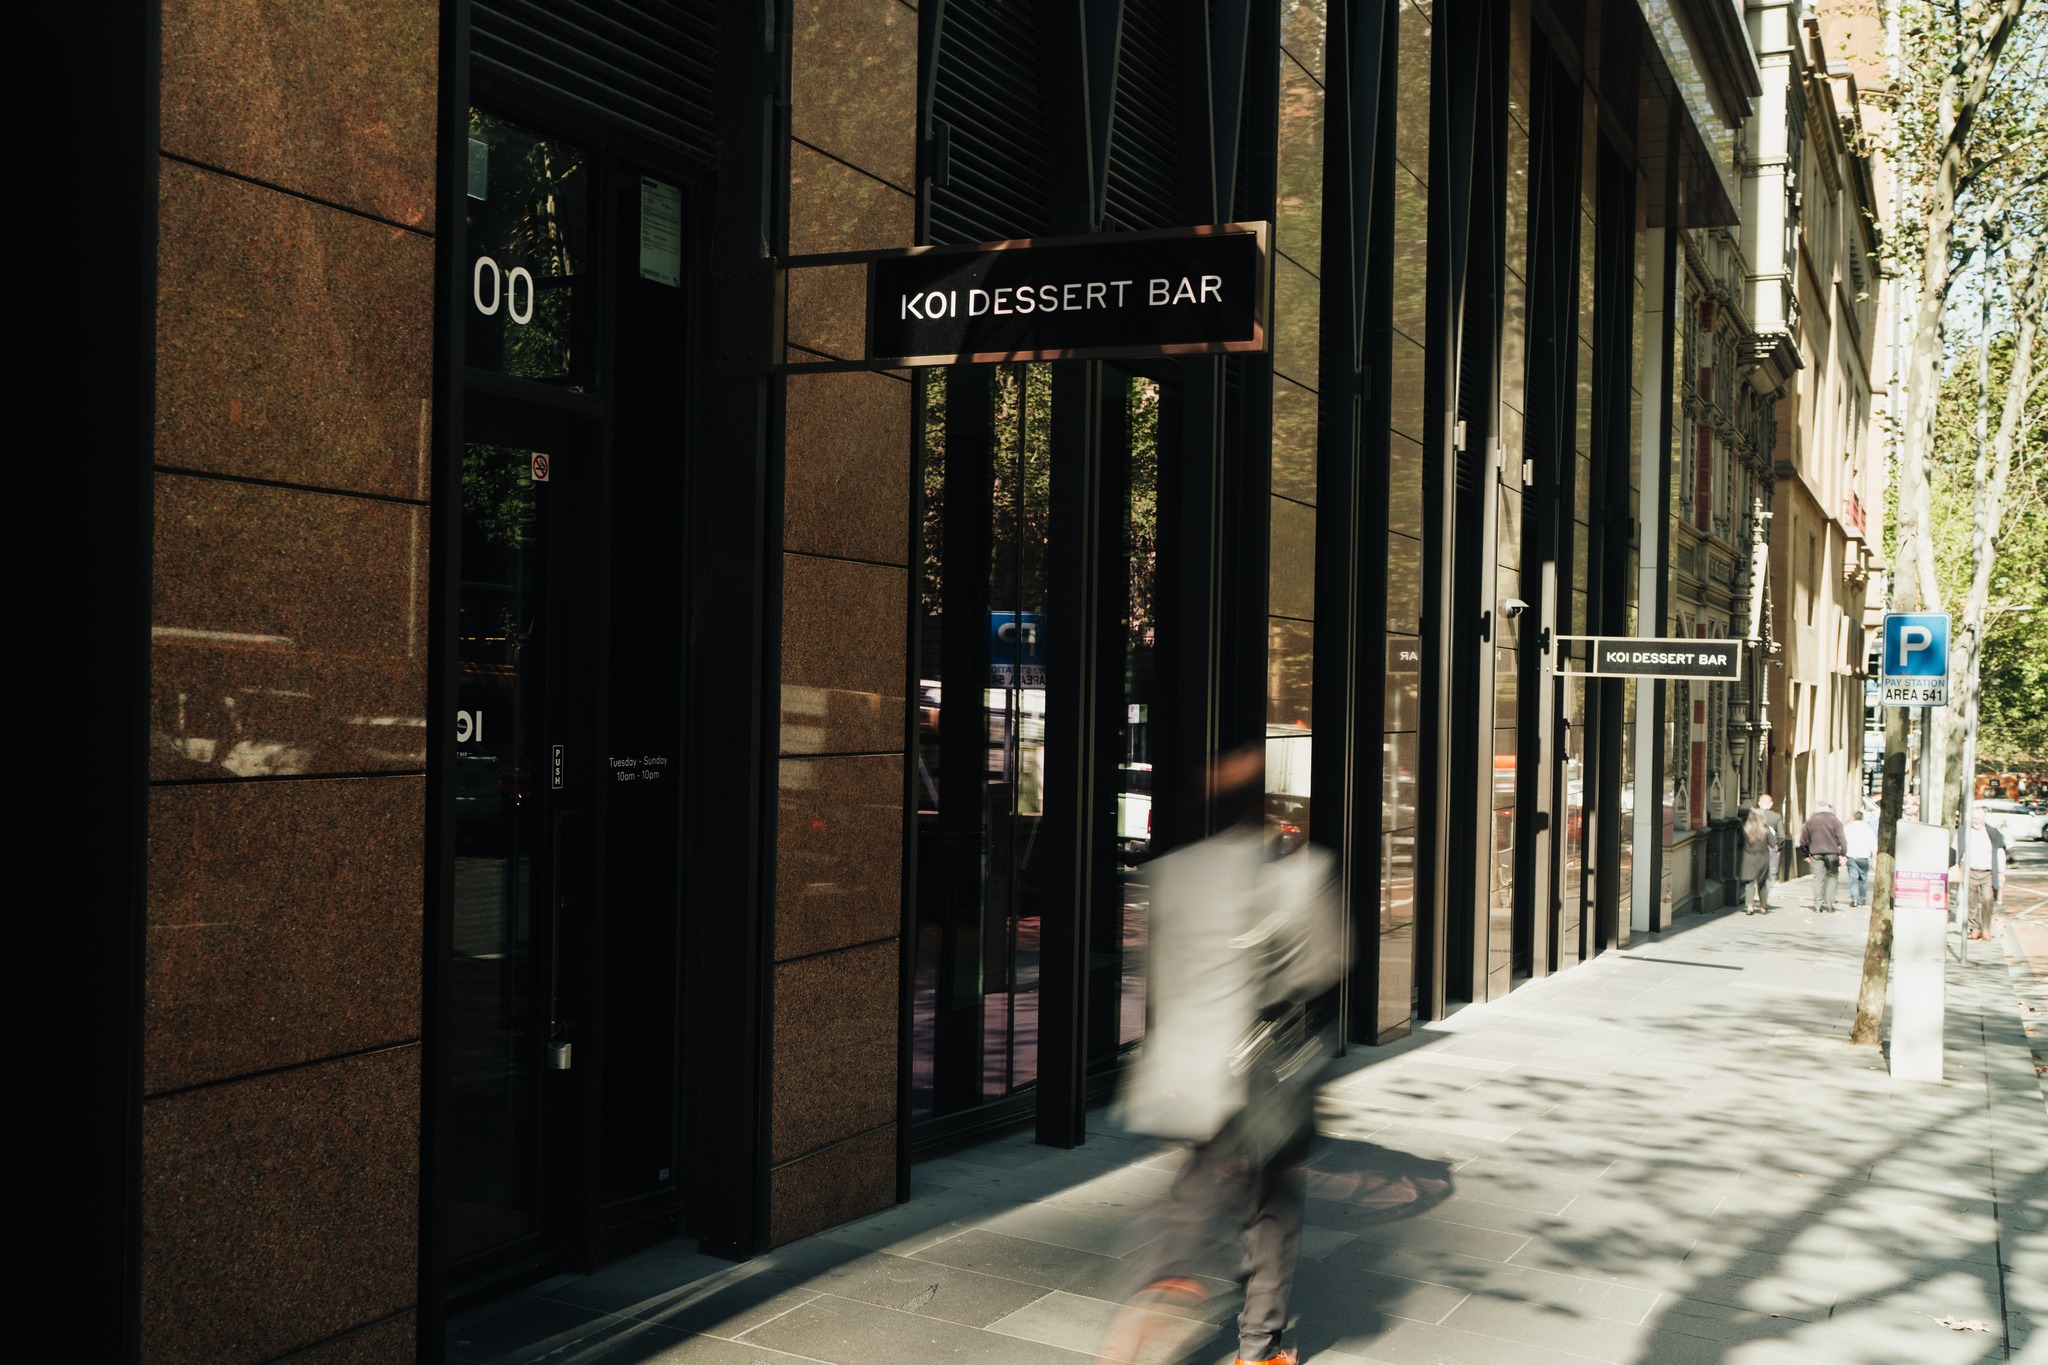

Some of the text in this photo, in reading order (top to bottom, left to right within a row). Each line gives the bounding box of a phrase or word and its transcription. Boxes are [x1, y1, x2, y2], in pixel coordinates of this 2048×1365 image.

[473, 256, 534, 325] 00
[901, 275, 1222, 320] KOI DESSERT BAR
[1899, 626, 1933, 667] P
[1606, 651, 1727, 666] KOI DESSERT BAR
[1885, 678, 1945, 688] PAY STATION
[1885, 688, 1942, 702] AREA 541
[456, 710, 483, 743] OI
[608, 756, 637, 769] Tuesday
[643, 755, 668, 767] Sunday
[616, 771, 636, 782] 10am
[642, 769, 660, 782] 10pm
